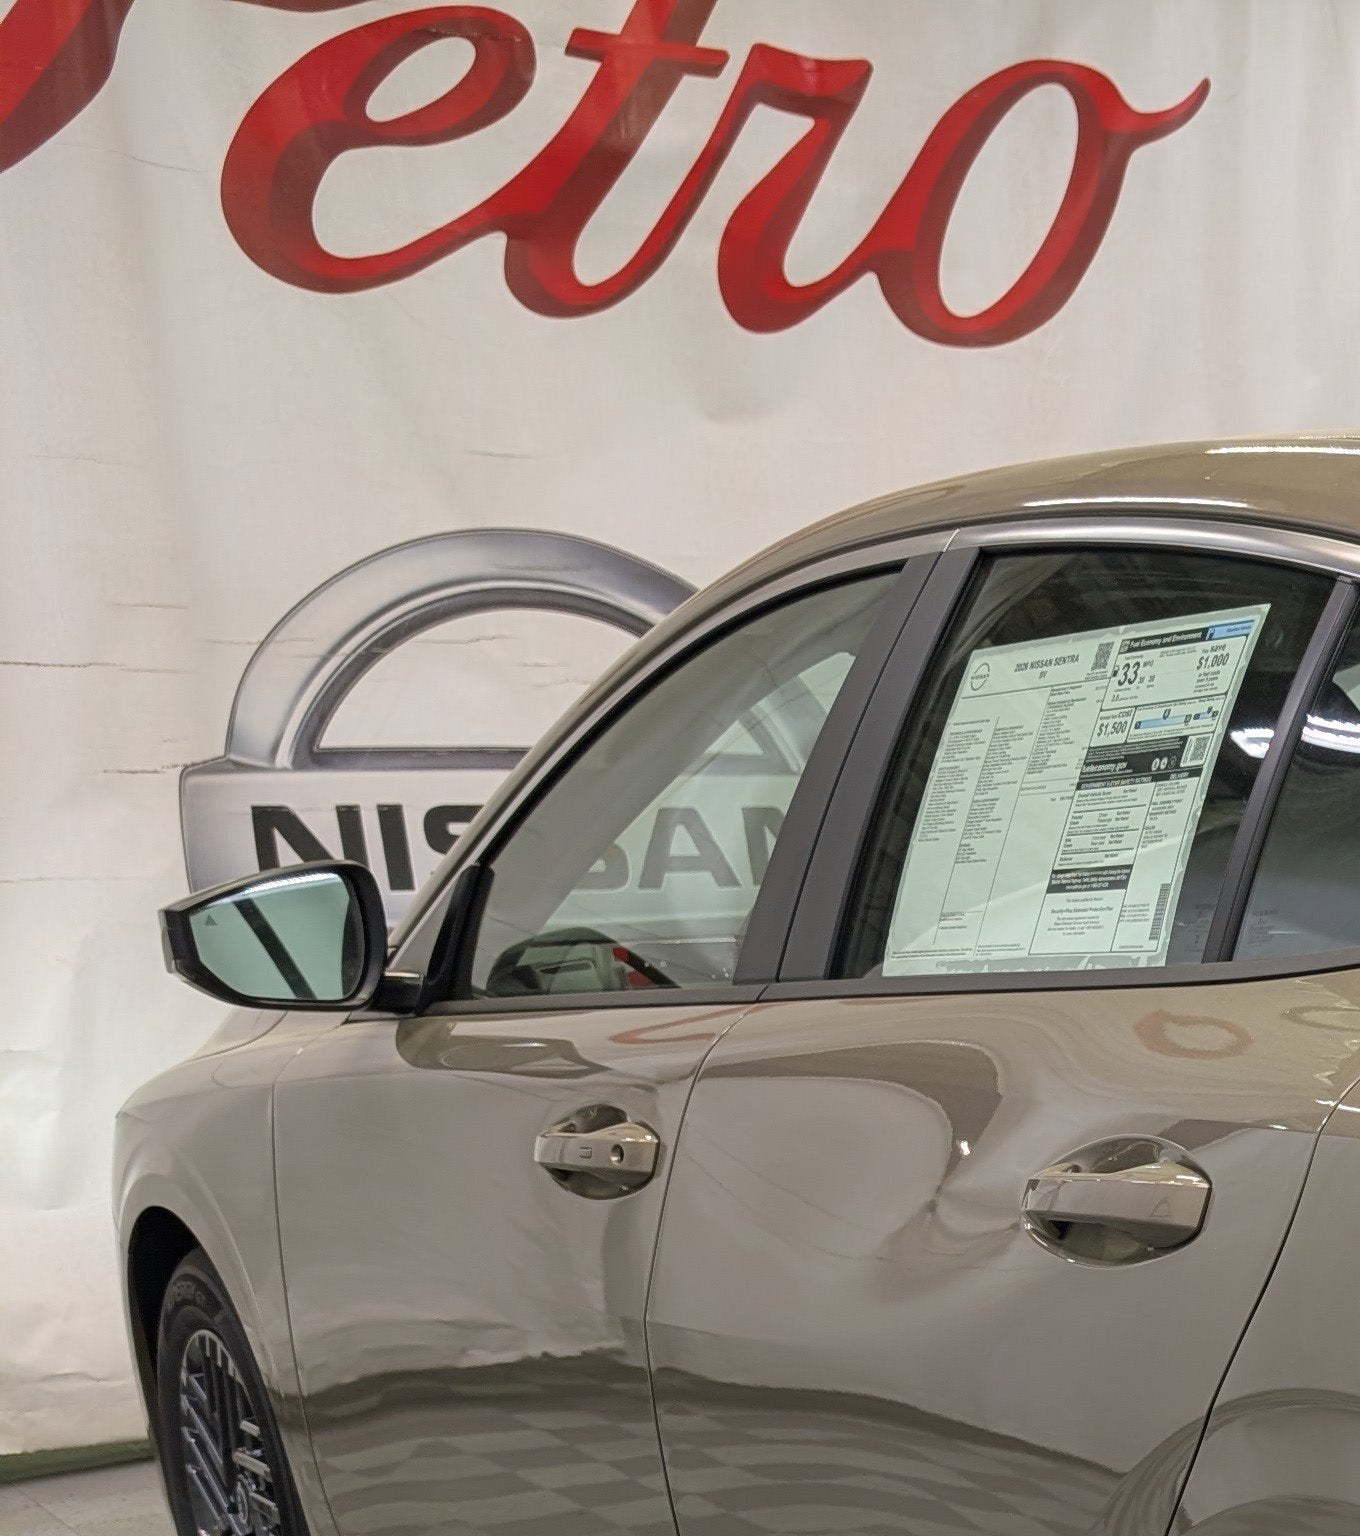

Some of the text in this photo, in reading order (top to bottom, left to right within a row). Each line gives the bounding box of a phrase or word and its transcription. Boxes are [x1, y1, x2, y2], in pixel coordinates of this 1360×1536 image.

[0, 0, 1211, 348] etro
[1197, 653, 1230, 671] $1,000
[1117, 661, 1141, 686] 33
[1096, 721, 1128, 737] $1,500
